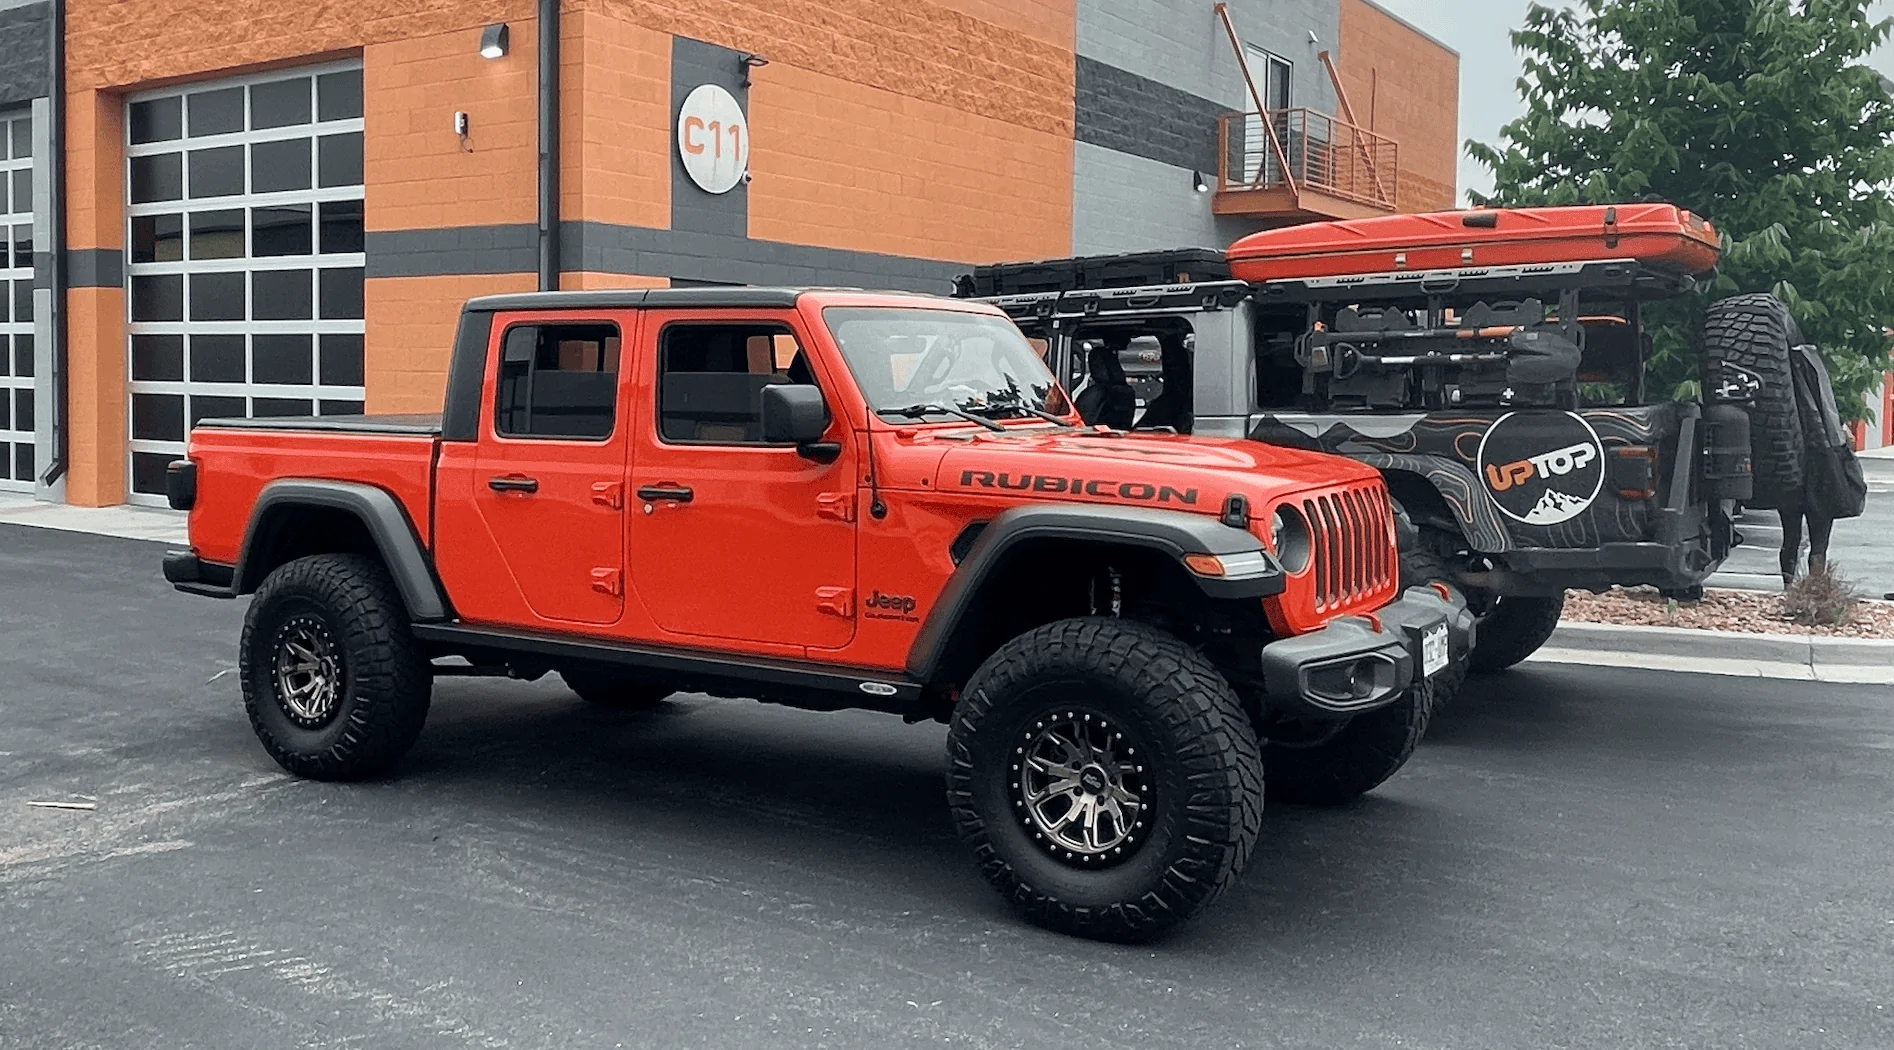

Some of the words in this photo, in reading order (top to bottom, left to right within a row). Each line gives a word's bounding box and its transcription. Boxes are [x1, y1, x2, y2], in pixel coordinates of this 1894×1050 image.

[684, 115, 740, 162] C11
[1485, 441, 1597, 492] UPTOP
[960, 470, 1198, 504] RUBICON
[865, 589, 917, 615] Jeep
